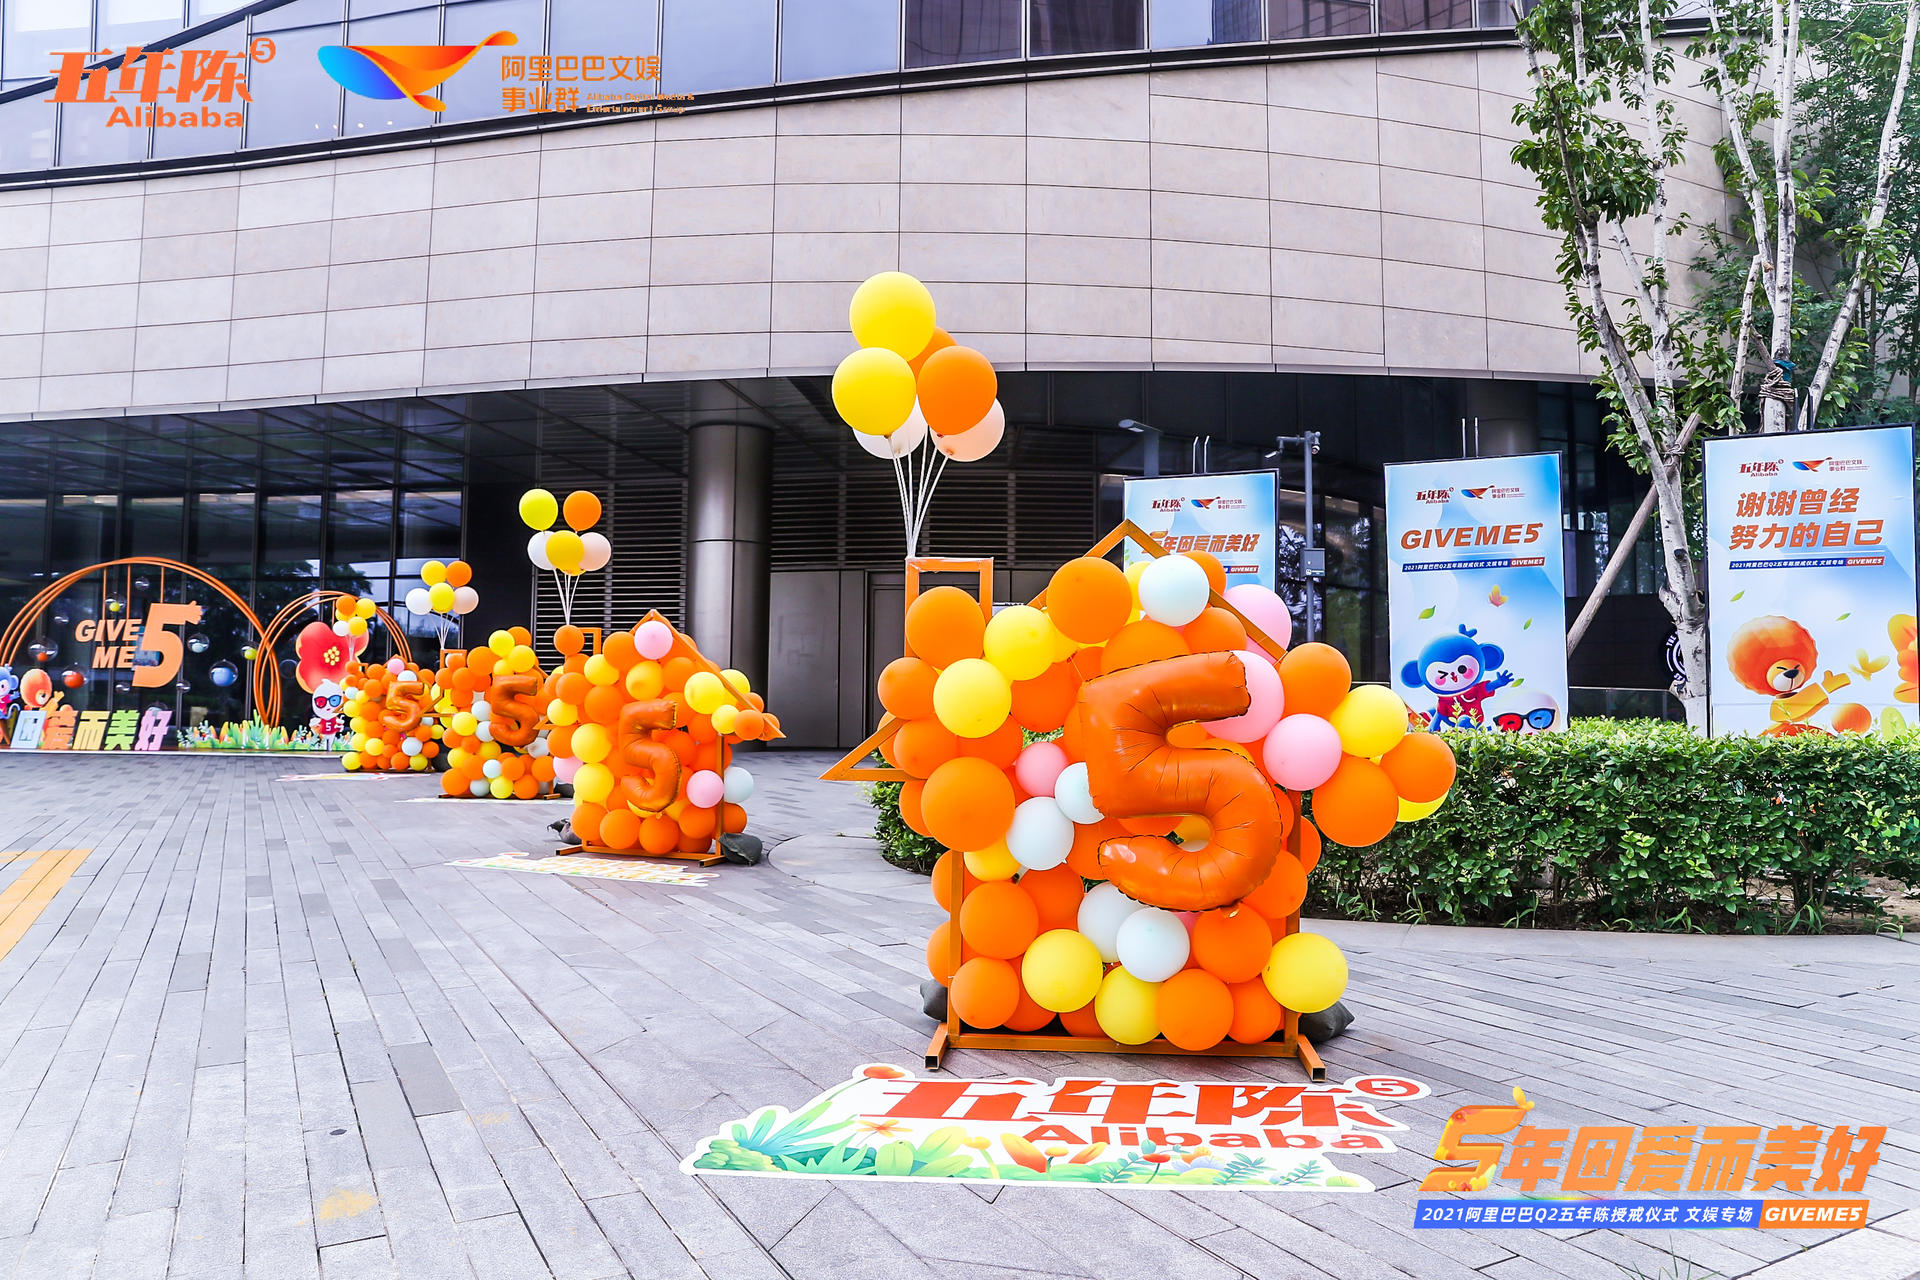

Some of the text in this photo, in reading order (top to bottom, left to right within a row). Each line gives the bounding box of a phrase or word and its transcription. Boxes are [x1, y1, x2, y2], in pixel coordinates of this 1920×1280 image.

[1736, 487, 1860, 518] 谢谢曾经
[1401, 522, 1544, 550] GIVEME5
[1729, 519, 1884, 550] 努力的自己
[75, 619, 142, 642] GIVE
[92, 600, 203, 688] ME 5
[860, 1079, 1397, 1128] 五年陈
[1020, 1125, 1385, 1150] Alibaba
